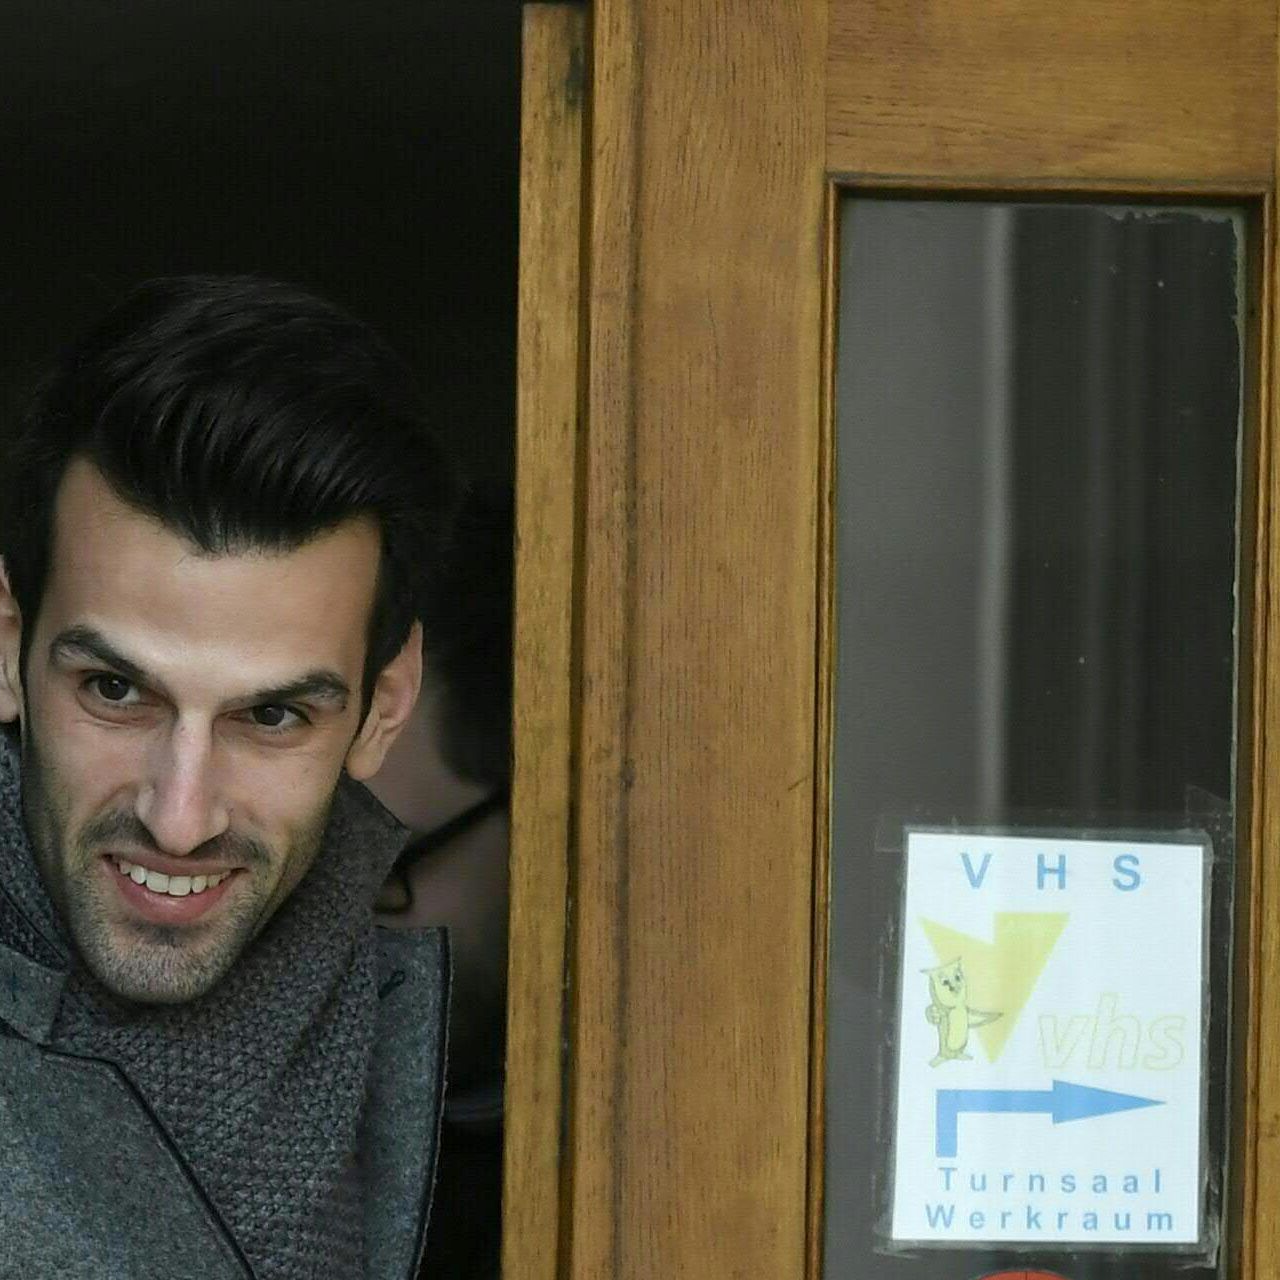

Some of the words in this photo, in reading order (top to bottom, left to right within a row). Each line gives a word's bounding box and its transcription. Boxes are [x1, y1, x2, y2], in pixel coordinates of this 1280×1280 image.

[1036, 992, 1187, 1073] vhs
[938, 1166, 1162, 1195] Turnsaal
[926, 1204, 1174, 1232] Werkraum
